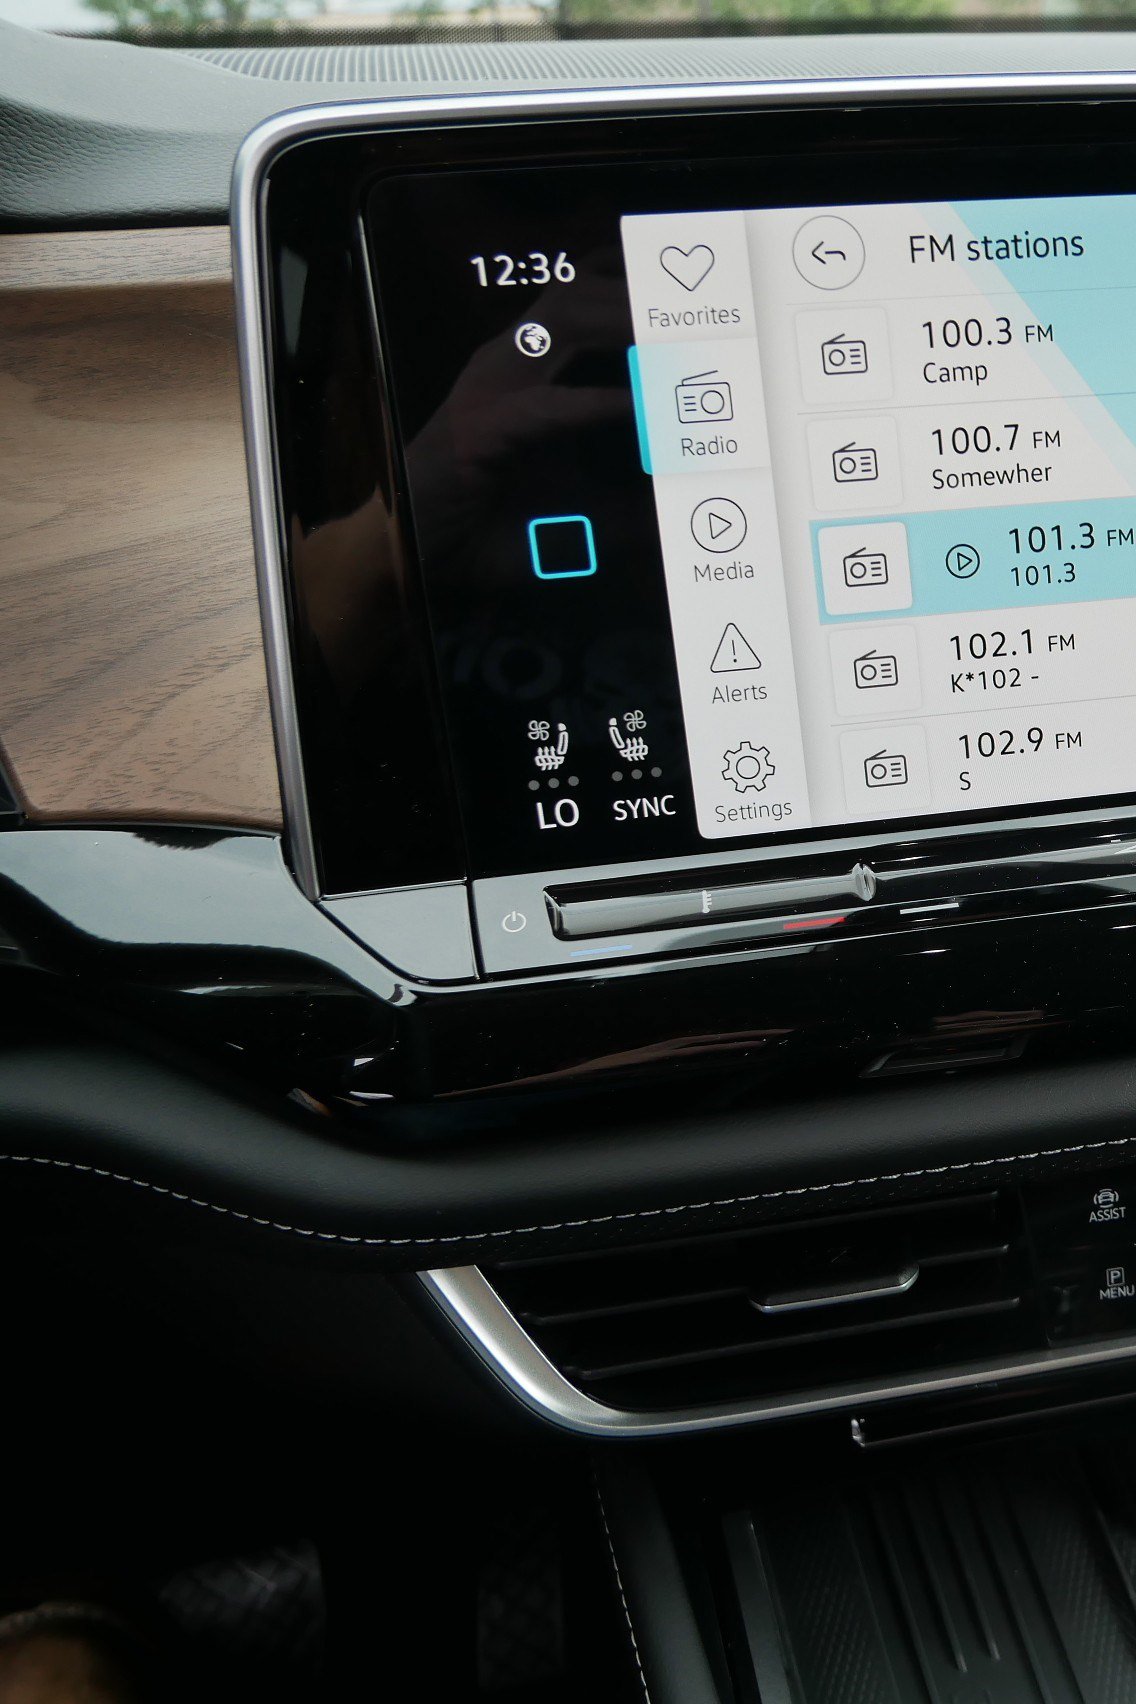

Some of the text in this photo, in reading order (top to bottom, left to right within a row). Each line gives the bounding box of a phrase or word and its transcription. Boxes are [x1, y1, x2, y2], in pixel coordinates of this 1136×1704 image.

[910, 231, 1083, 263] FM stations
[470, 251, 576, 287] 12:36
[649, 306, 740, 327] Favorites
[923, 317, 1053, 348] 100.3 FM
[924, 363, 987, 385] Camp
[681, 436, 737, 456] Radio
[932, 424, 1060, 455] 100.7 FM
[933, 463, 1052, 489] Somewher
[1009, 523, 1134, 553] 101.3 FM
[694, 561, 754, 582] Media
[1011, 563, 1075, 586] 101.3
[950, 629, 1075, 660] 102.1 FM
[712, 685, 767, 703] Alerts
[959, 727, 1081, 759] 102.9 FM
[960, 772, 971, 790] S
[537, 799, 579, 829] LO
[613, 795, 676, 820] SYNC
[715, 801, 792, 825] Settings
[1089, 1206, 1125, 1222] ASSIST
[1110, 1269, 1121, 1284] P
[1100, 1285, 1134, 1299] MENU
